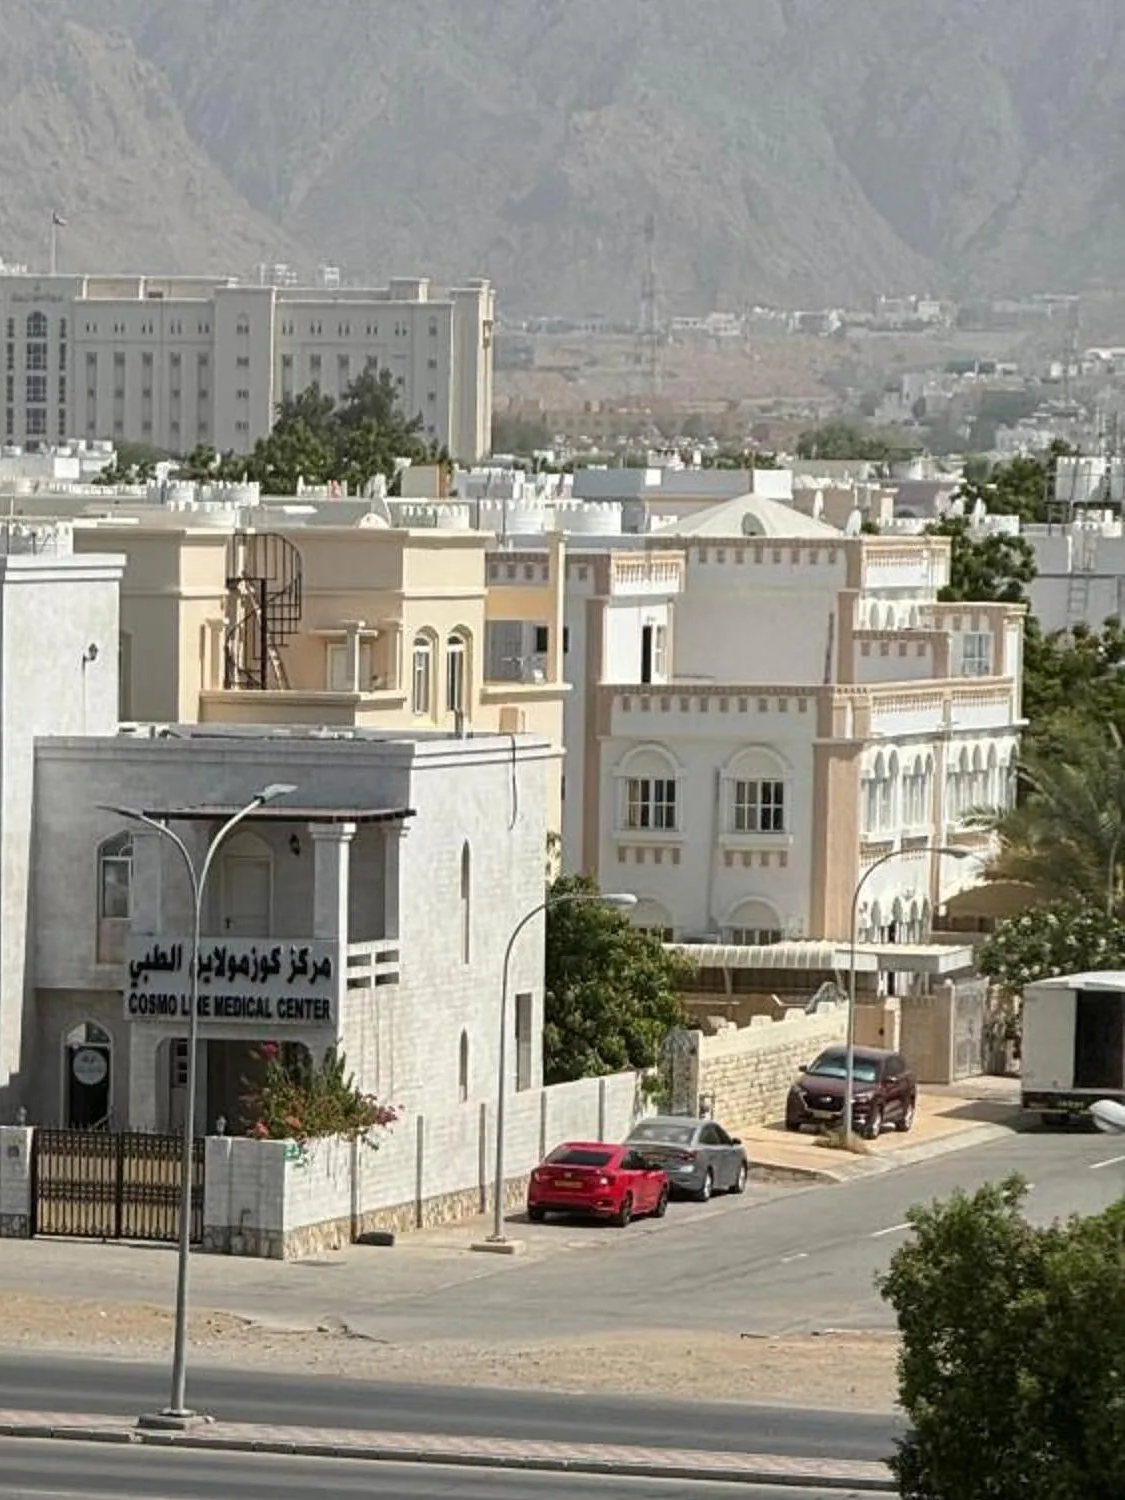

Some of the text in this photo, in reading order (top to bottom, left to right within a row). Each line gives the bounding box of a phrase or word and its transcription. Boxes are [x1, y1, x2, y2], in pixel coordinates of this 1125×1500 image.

[129, 943, 183, 989] الطبي
[286, 945, 332, 986] مركز
[129, 993, 178, 1015] COSMO
[214, 995, 273, 1019] MEDICAL
[276, 997, 331, 1020] CENTER
